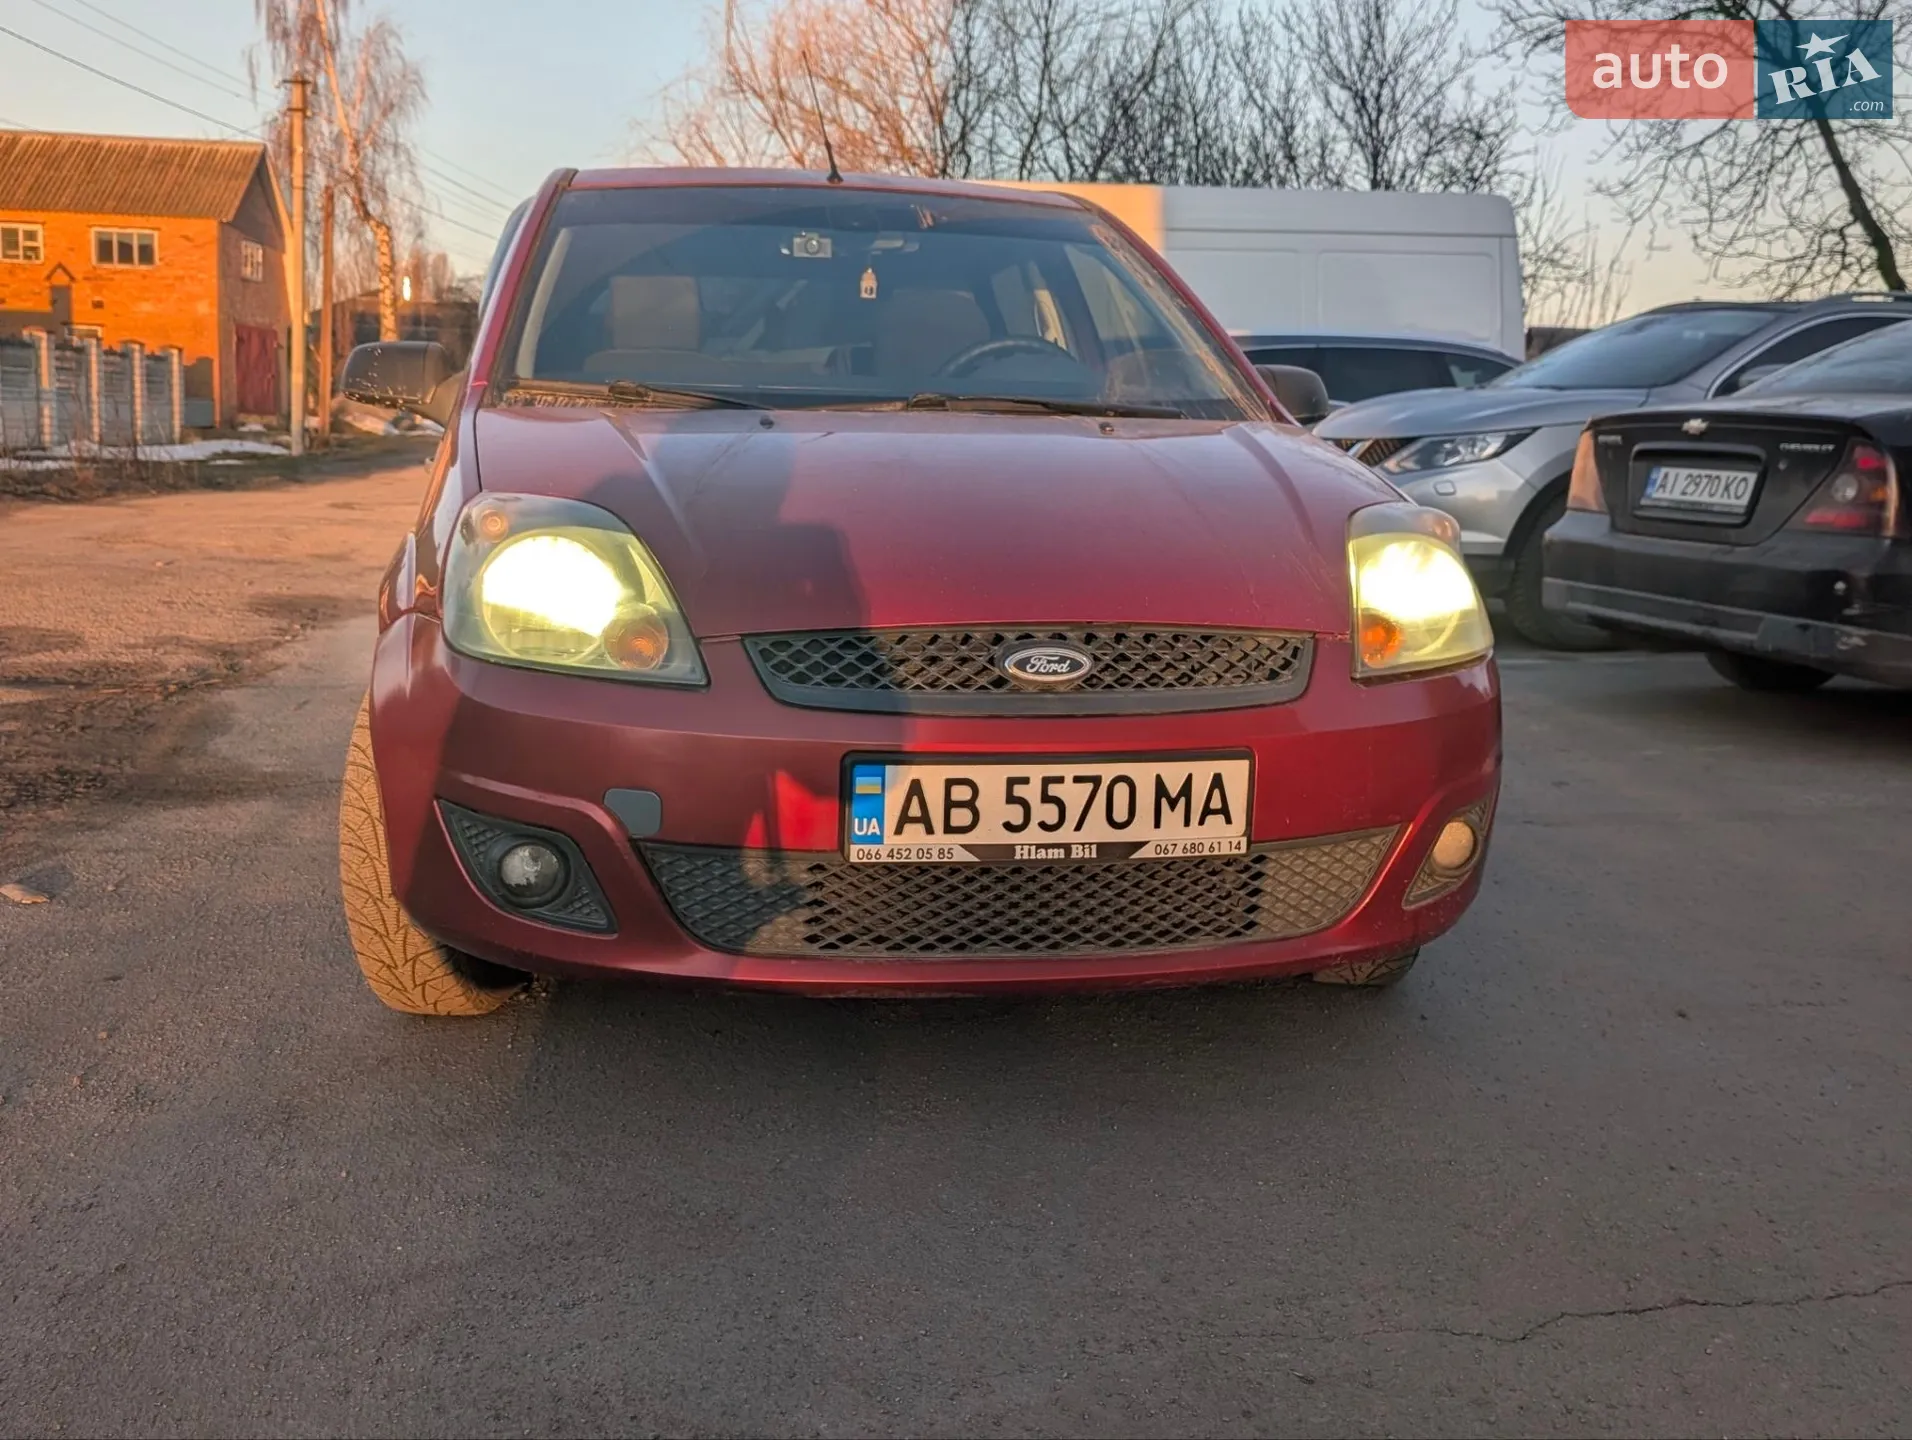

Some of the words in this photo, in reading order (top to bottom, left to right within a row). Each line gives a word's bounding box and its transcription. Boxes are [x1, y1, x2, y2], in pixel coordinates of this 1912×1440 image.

[1656, 471, 1679, 495] AI
[1680, 473, 1721, 498] 2970
[1720, 475, 1749, 500] KO
[1026, 655, 1071, 673] Ford
[893, 777, 981, 836] AB
[1002, 773, 1137, 833] 5570
[1153, 772, 1234, 829] MA
[854, 817, 881, 836] UA
[856, 848, 882, 861] 066
[886, 847, 912, 860] 452
[916, 847, 933, 860] 05
[937, 847, 954, 860] 85
[1014, 844, 1065, 859] Hlam
[1070, 844, 1097, 858] Bil
[1154, 843, 1178, 856] 067
[1182, 841, 1205, 854] 680
[1208, 841, 1221, 853] 61
[1228, 840, 1241, 852] 14
